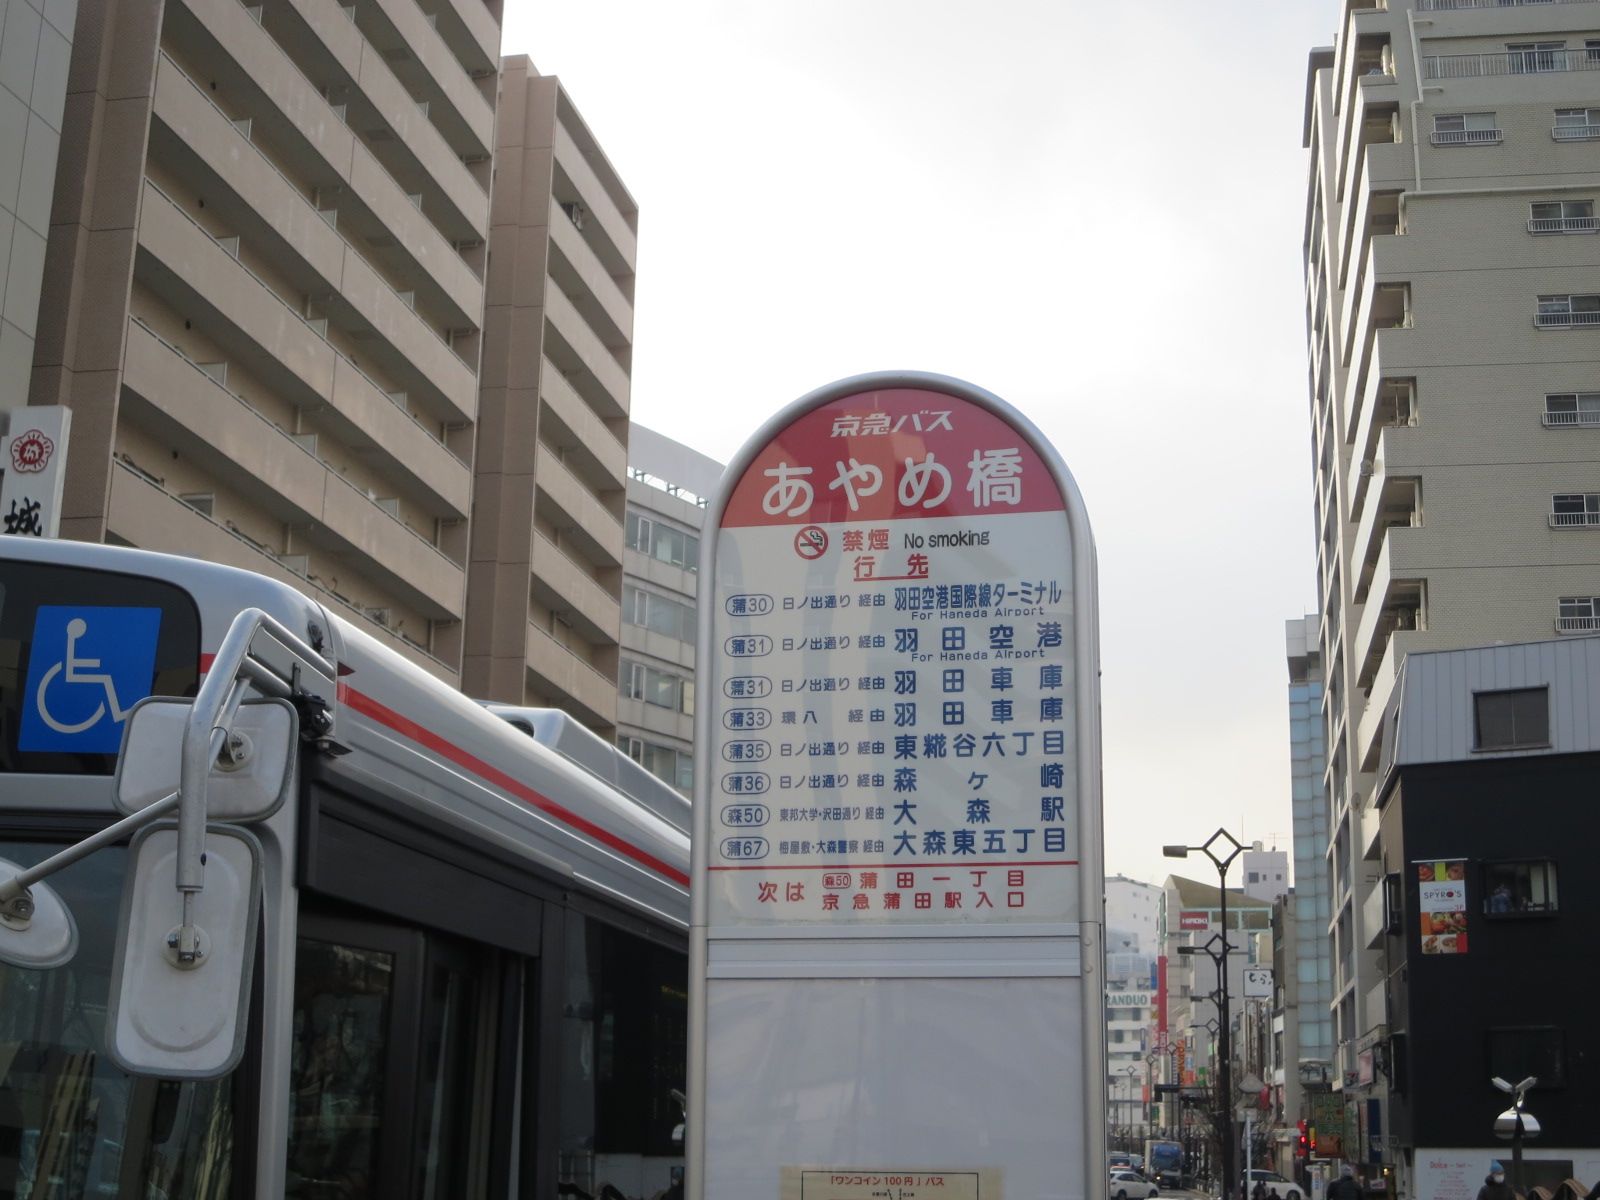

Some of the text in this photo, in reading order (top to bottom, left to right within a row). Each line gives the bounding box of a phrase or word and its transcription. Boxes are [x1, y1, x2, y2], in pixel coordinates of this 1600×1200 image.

[831, 410, 953, 437] 京急バス
[762, 448, 1022, 517] あやめ橋
[842, 529, 990, 552] 禁煙 No smoking
[854, 554, 929, 578] 行先
[732, 598, 767, 613] 蒲30
[894, 580, 1062, 611] 羽田空港国際線ターミナル
[911, 606, 1044, 620] For Haneda Airport
[732, 639, 764, 654] 蒲31
[894, 621, 1062, 653] 羽田空港
[911, 648, 1045, 662] For Haneda Airport
[731, 680, 763, 695] 蒲31
[894, 664, 1063, 695] 羽田車庫
[730, 711, 765, 727] 蒲33
[894, 697, 1063, 727] 羽田車庫
[729, 744, 765, 759] 蒲35
[728, 776, 764, 792] 蒲36
[727, 808, 763, 824] 森50
[893, 797, 1065, 825] 大森駅
[727, 841, 763, 857] 蒲67
[893, 828, 1065, 856] 大森東五丁目
[758, 881, 805, 903] 次は
[822, 891, 1024, 910] 京急蒲田駅入口
